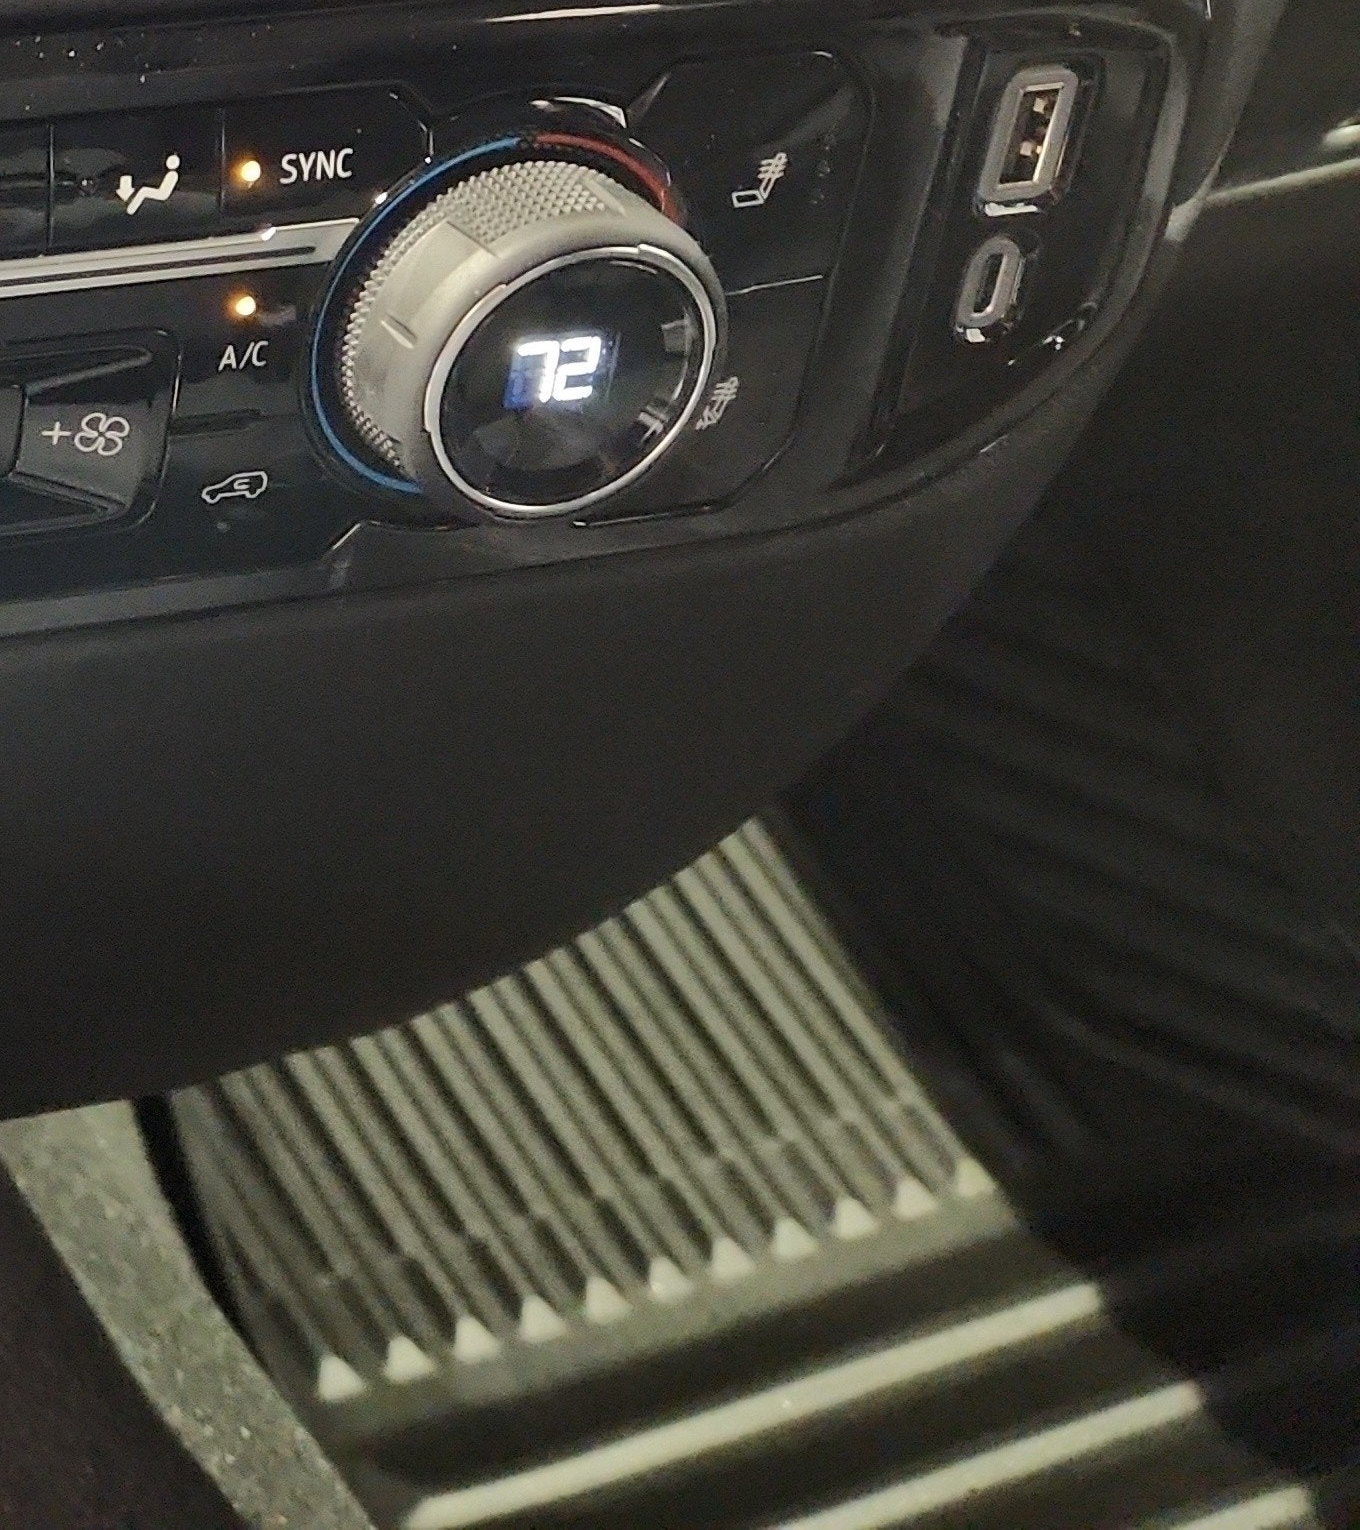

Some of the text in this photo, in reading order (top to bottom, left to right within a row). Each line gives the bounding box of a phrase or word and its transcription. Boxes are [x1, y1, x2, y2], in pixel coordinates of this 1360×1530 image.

[280, 148, 354, 184] SYNC
[218, 340, 269, 371] A/C
[517, 336, 602, 403] 72
